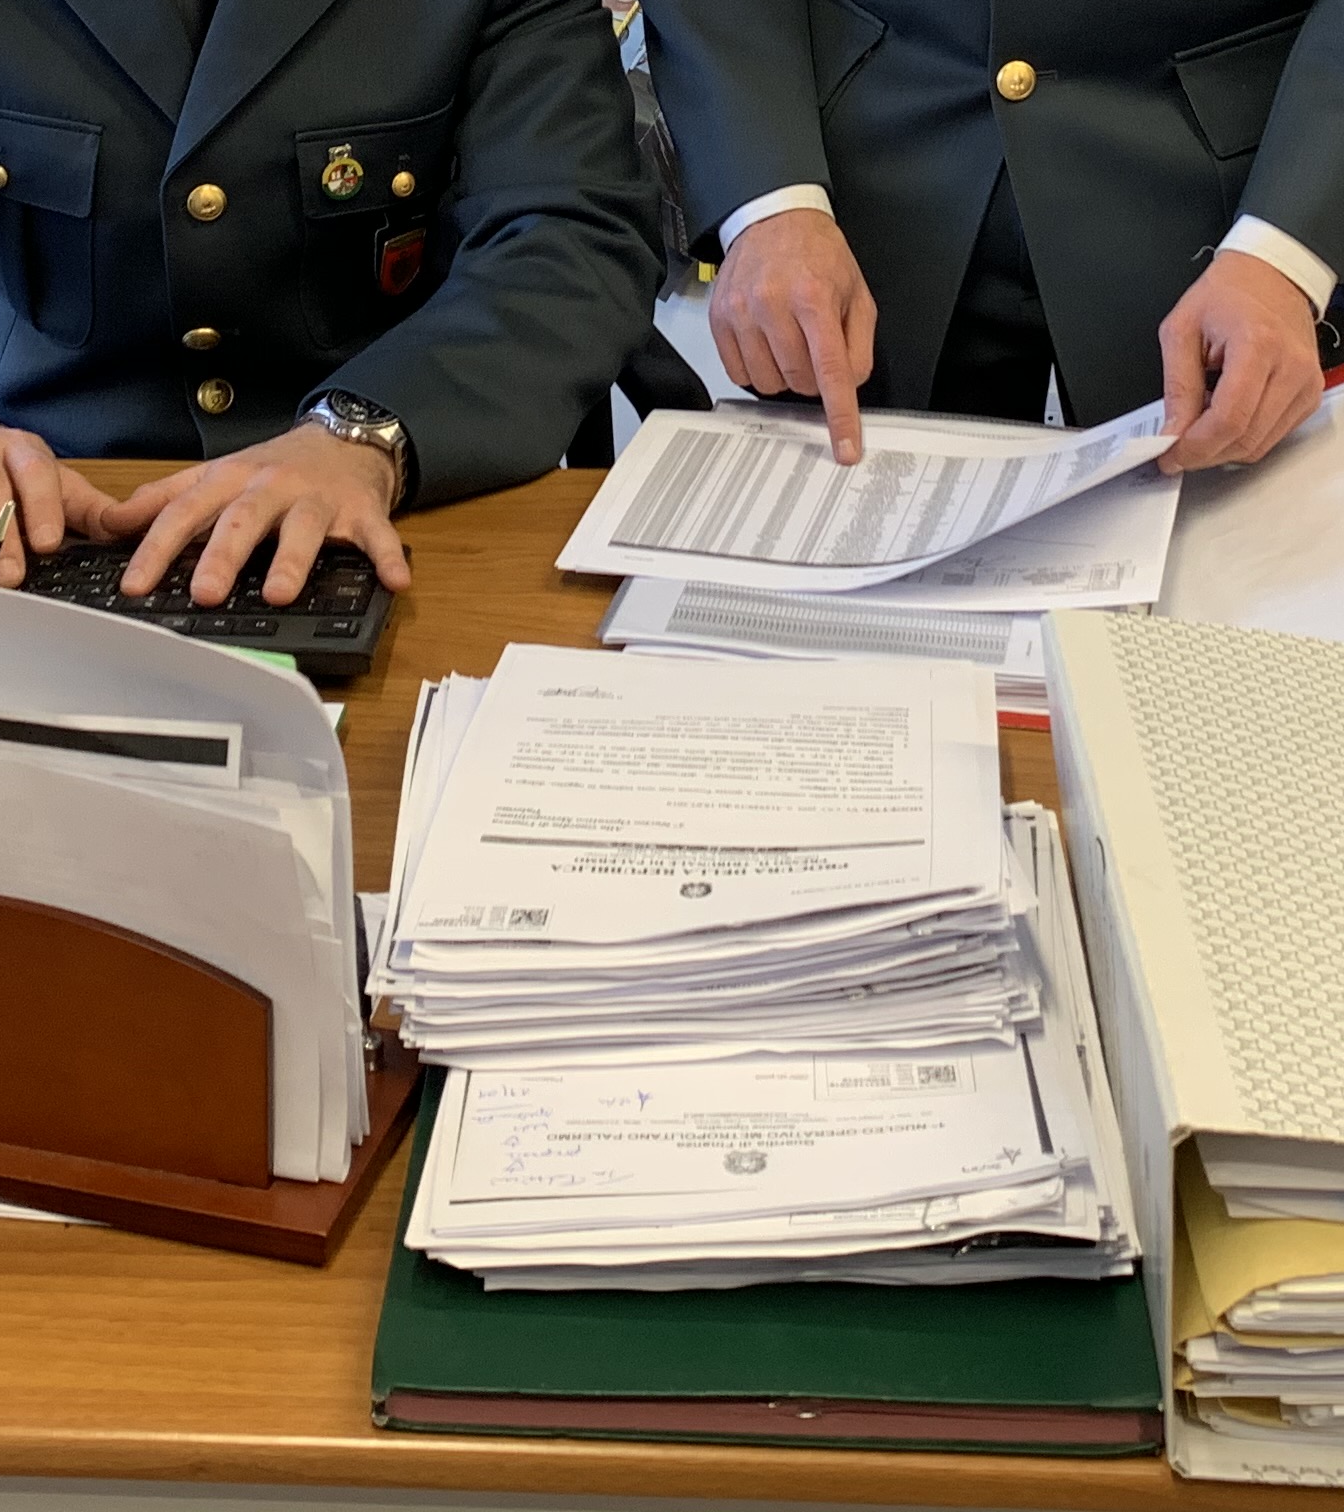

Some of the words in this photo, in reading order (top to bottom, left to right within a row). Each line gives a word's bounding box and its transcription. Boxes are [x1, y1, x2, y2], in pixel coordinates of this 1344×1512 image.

[546, 1133, 623, 1142] PALERMO
[627, 1131, 761, 1141] METROPOLITANO
[767, 1128, 856, 1139] OPERATIVO
[756, 1140, 814, 1148] Guardia
